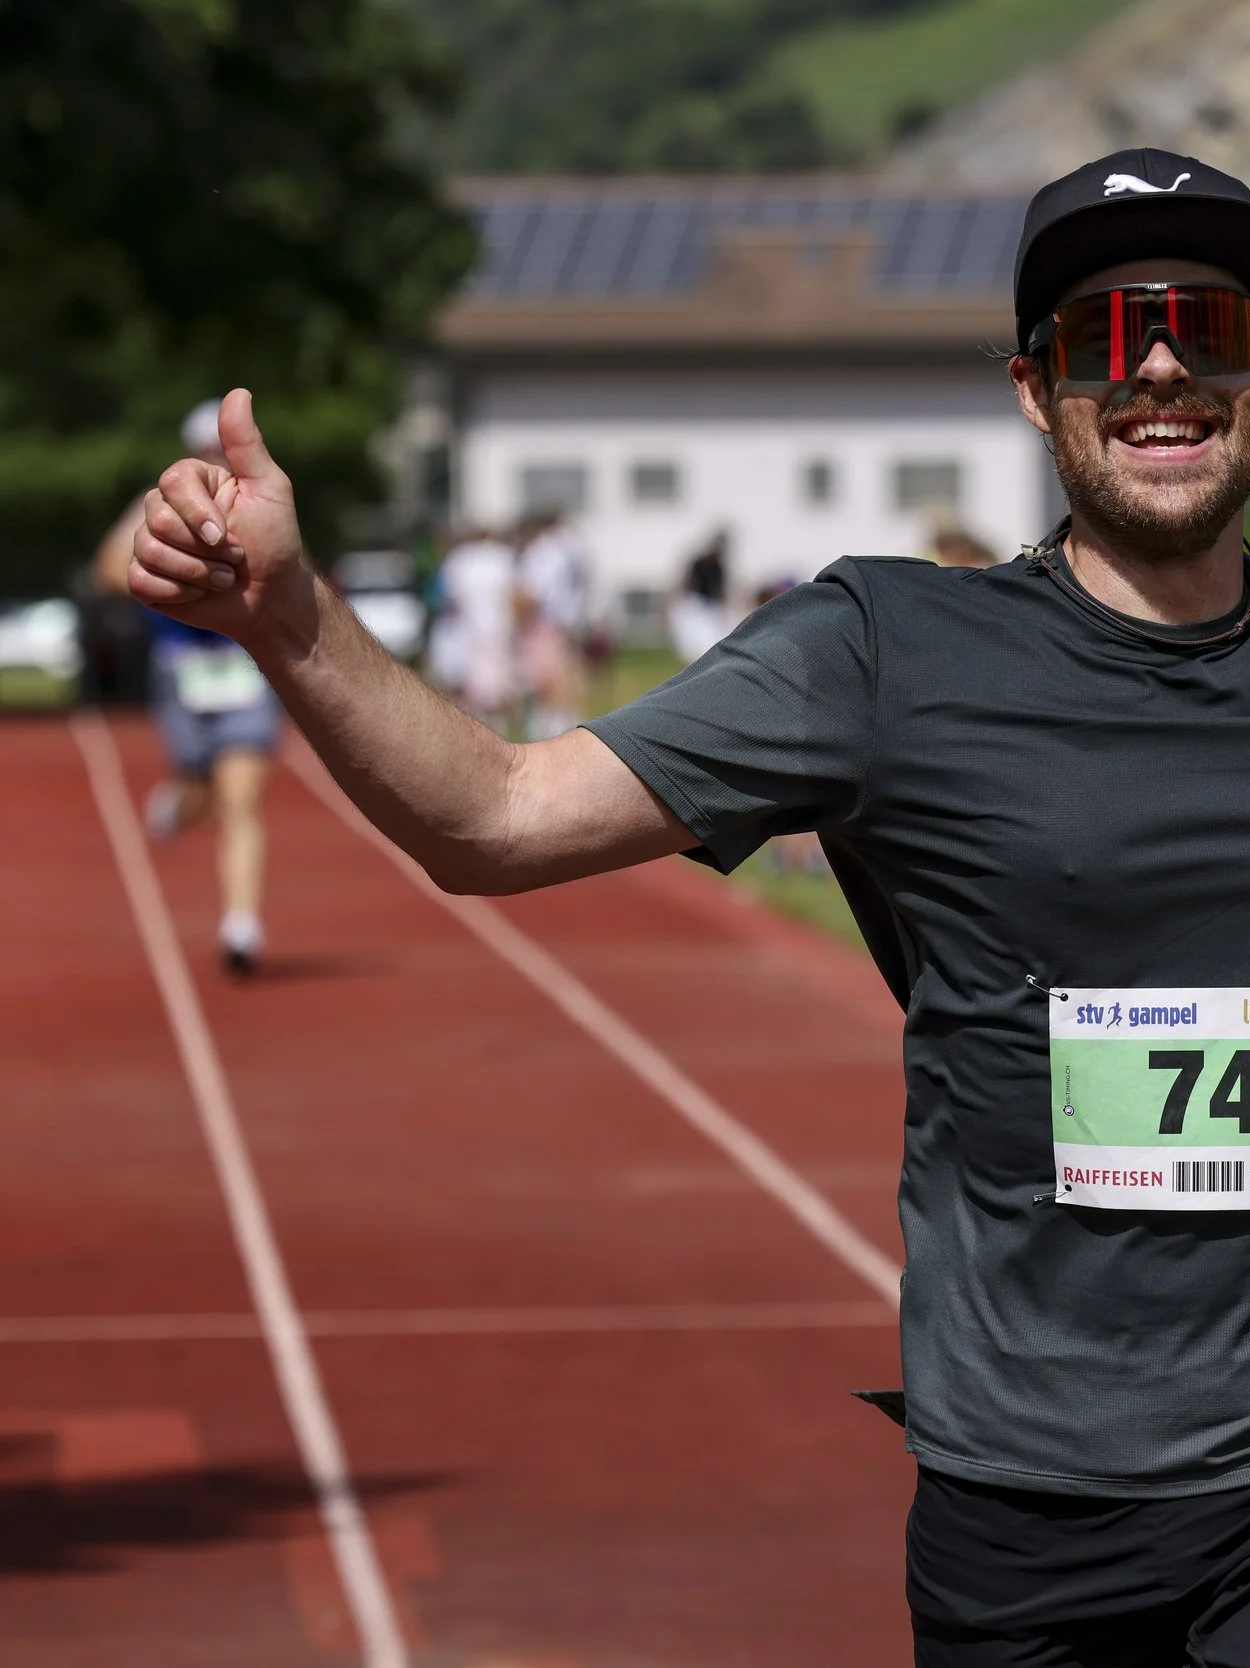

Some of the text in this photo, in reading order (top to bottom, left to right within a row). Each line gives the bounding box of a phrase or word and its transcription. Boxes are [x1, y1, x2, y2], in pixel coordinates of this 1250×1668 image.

[1077, 1002, 1197, 1027] stv gampel
[1063, 1166, 1164, 1187] RAIFFEISEN
